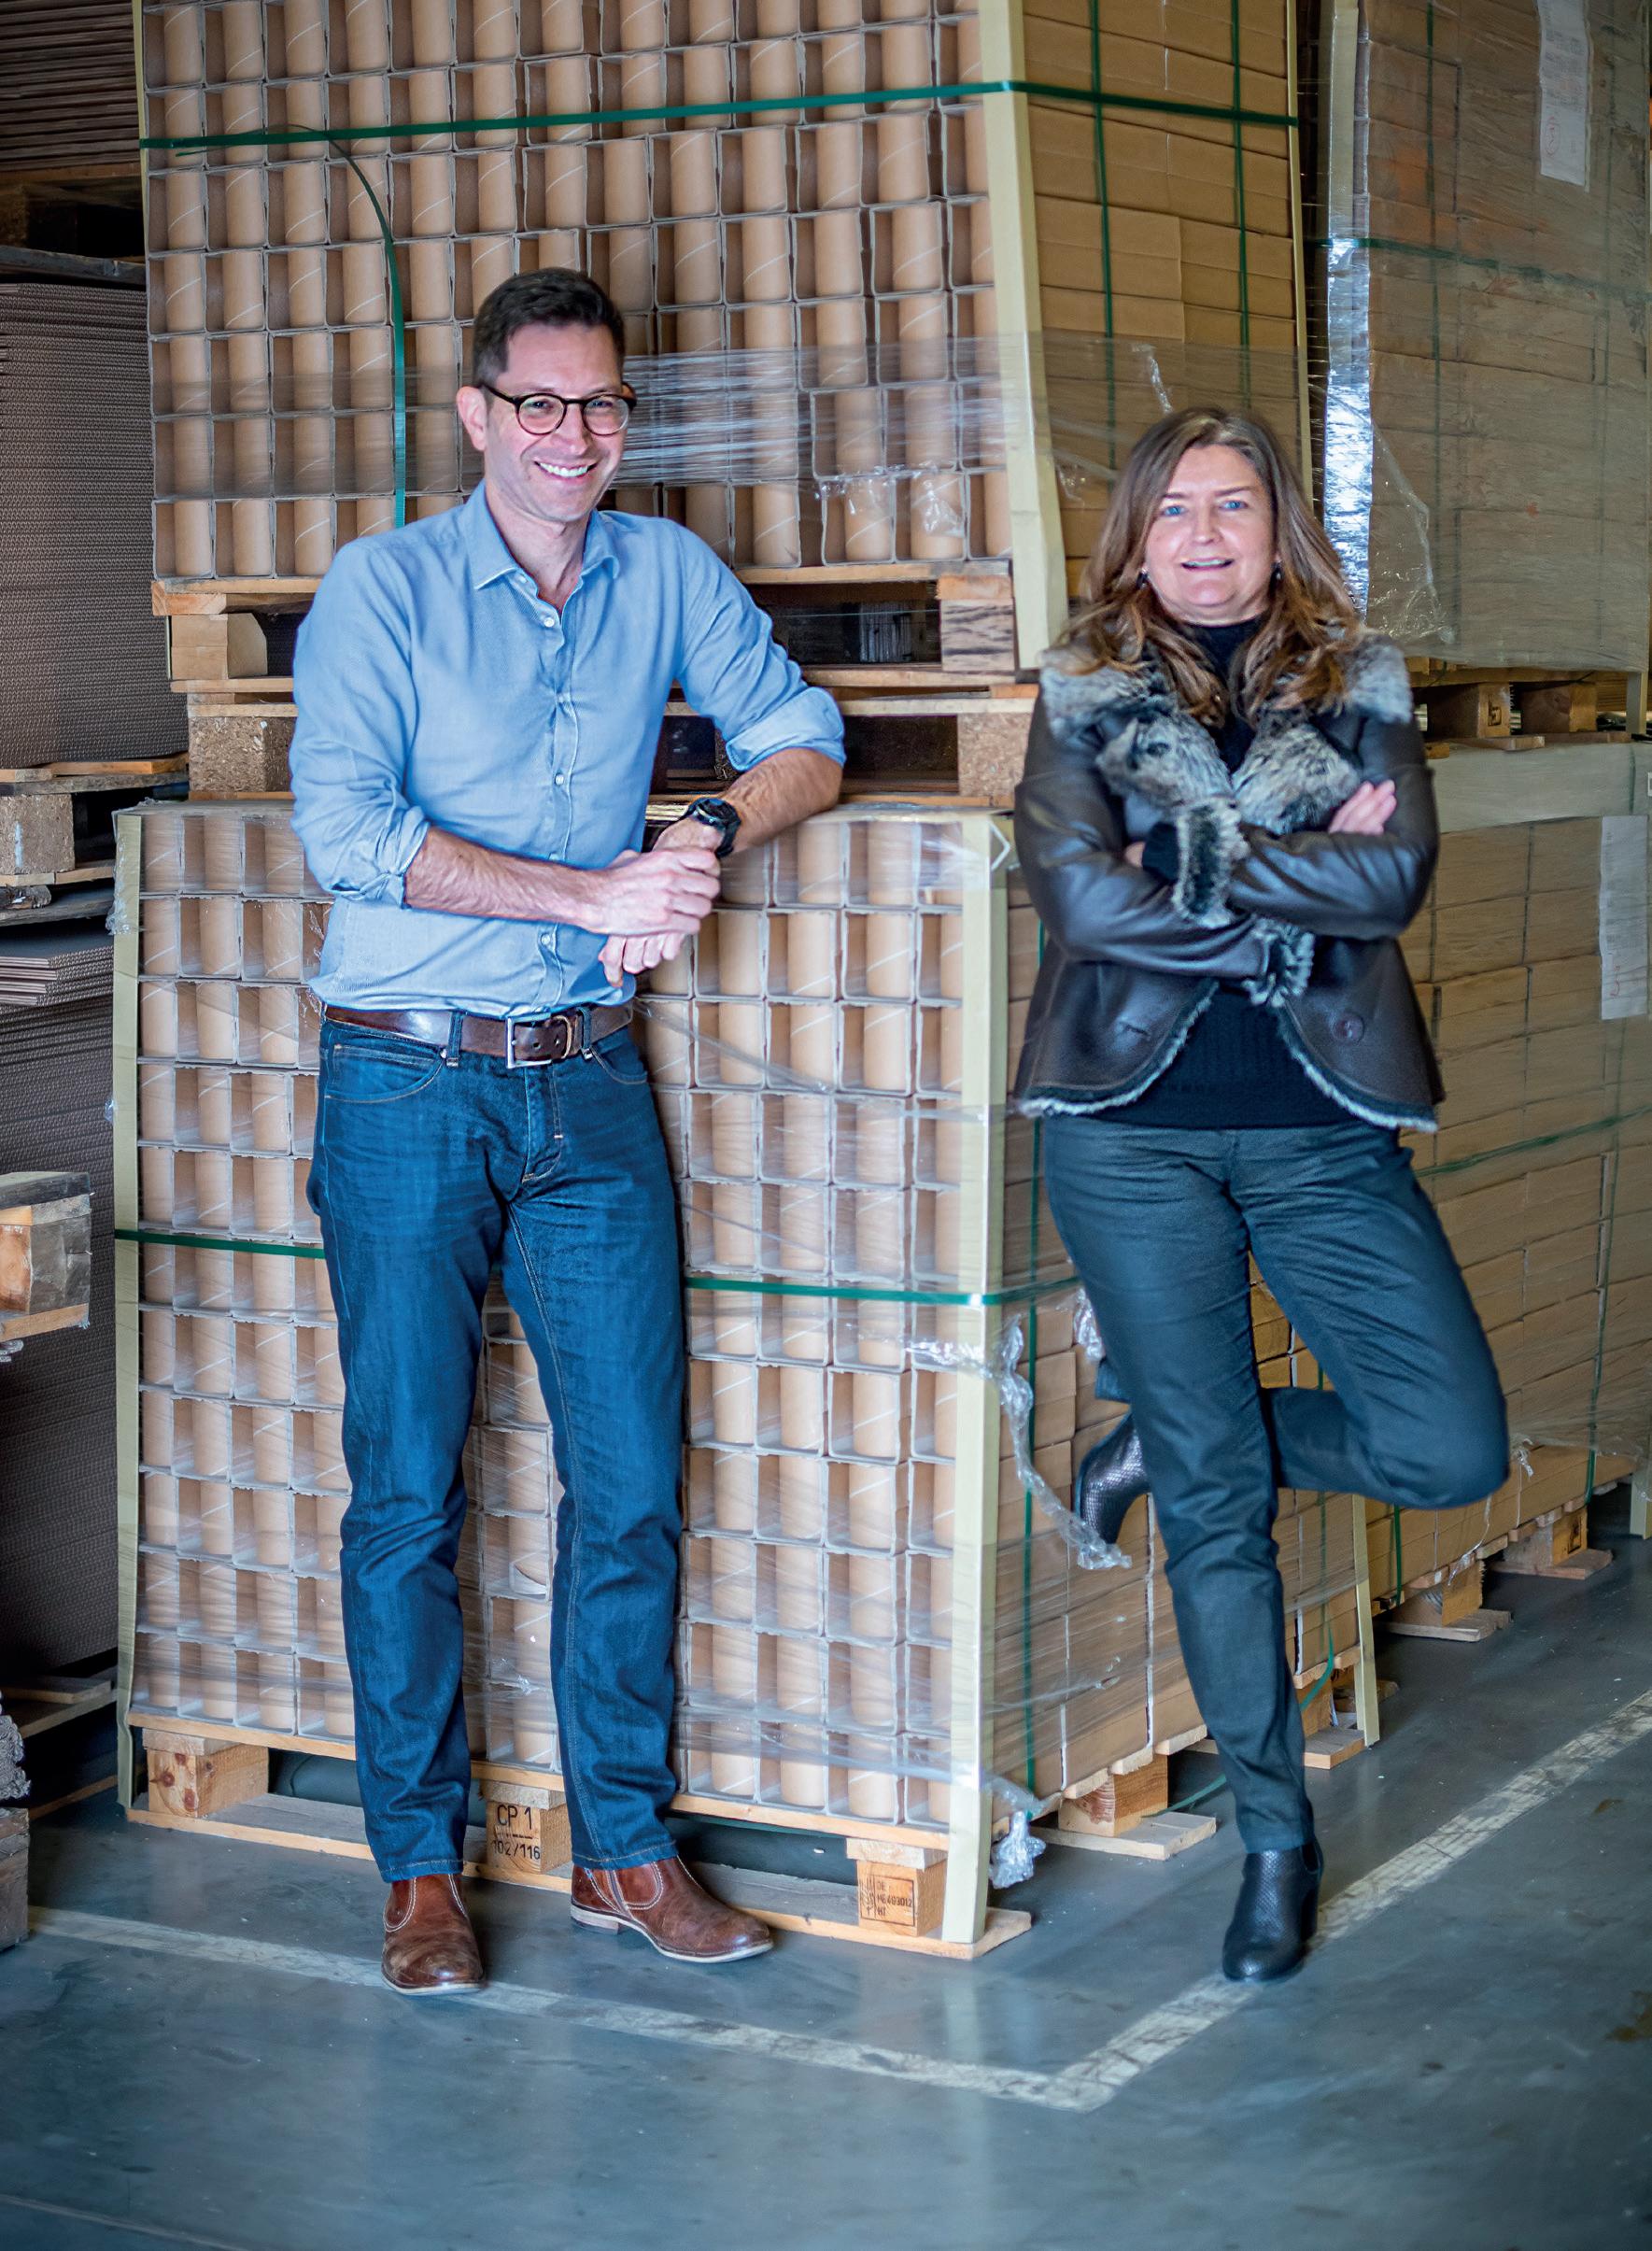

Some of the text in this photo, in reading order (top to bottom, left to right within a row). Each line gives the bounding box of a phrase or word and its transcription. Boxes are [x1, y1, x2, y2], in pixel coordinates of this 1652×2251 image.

[497, 1804, 532, 1831] CP 1
[490, 1840, 541, 1860] 102/116
